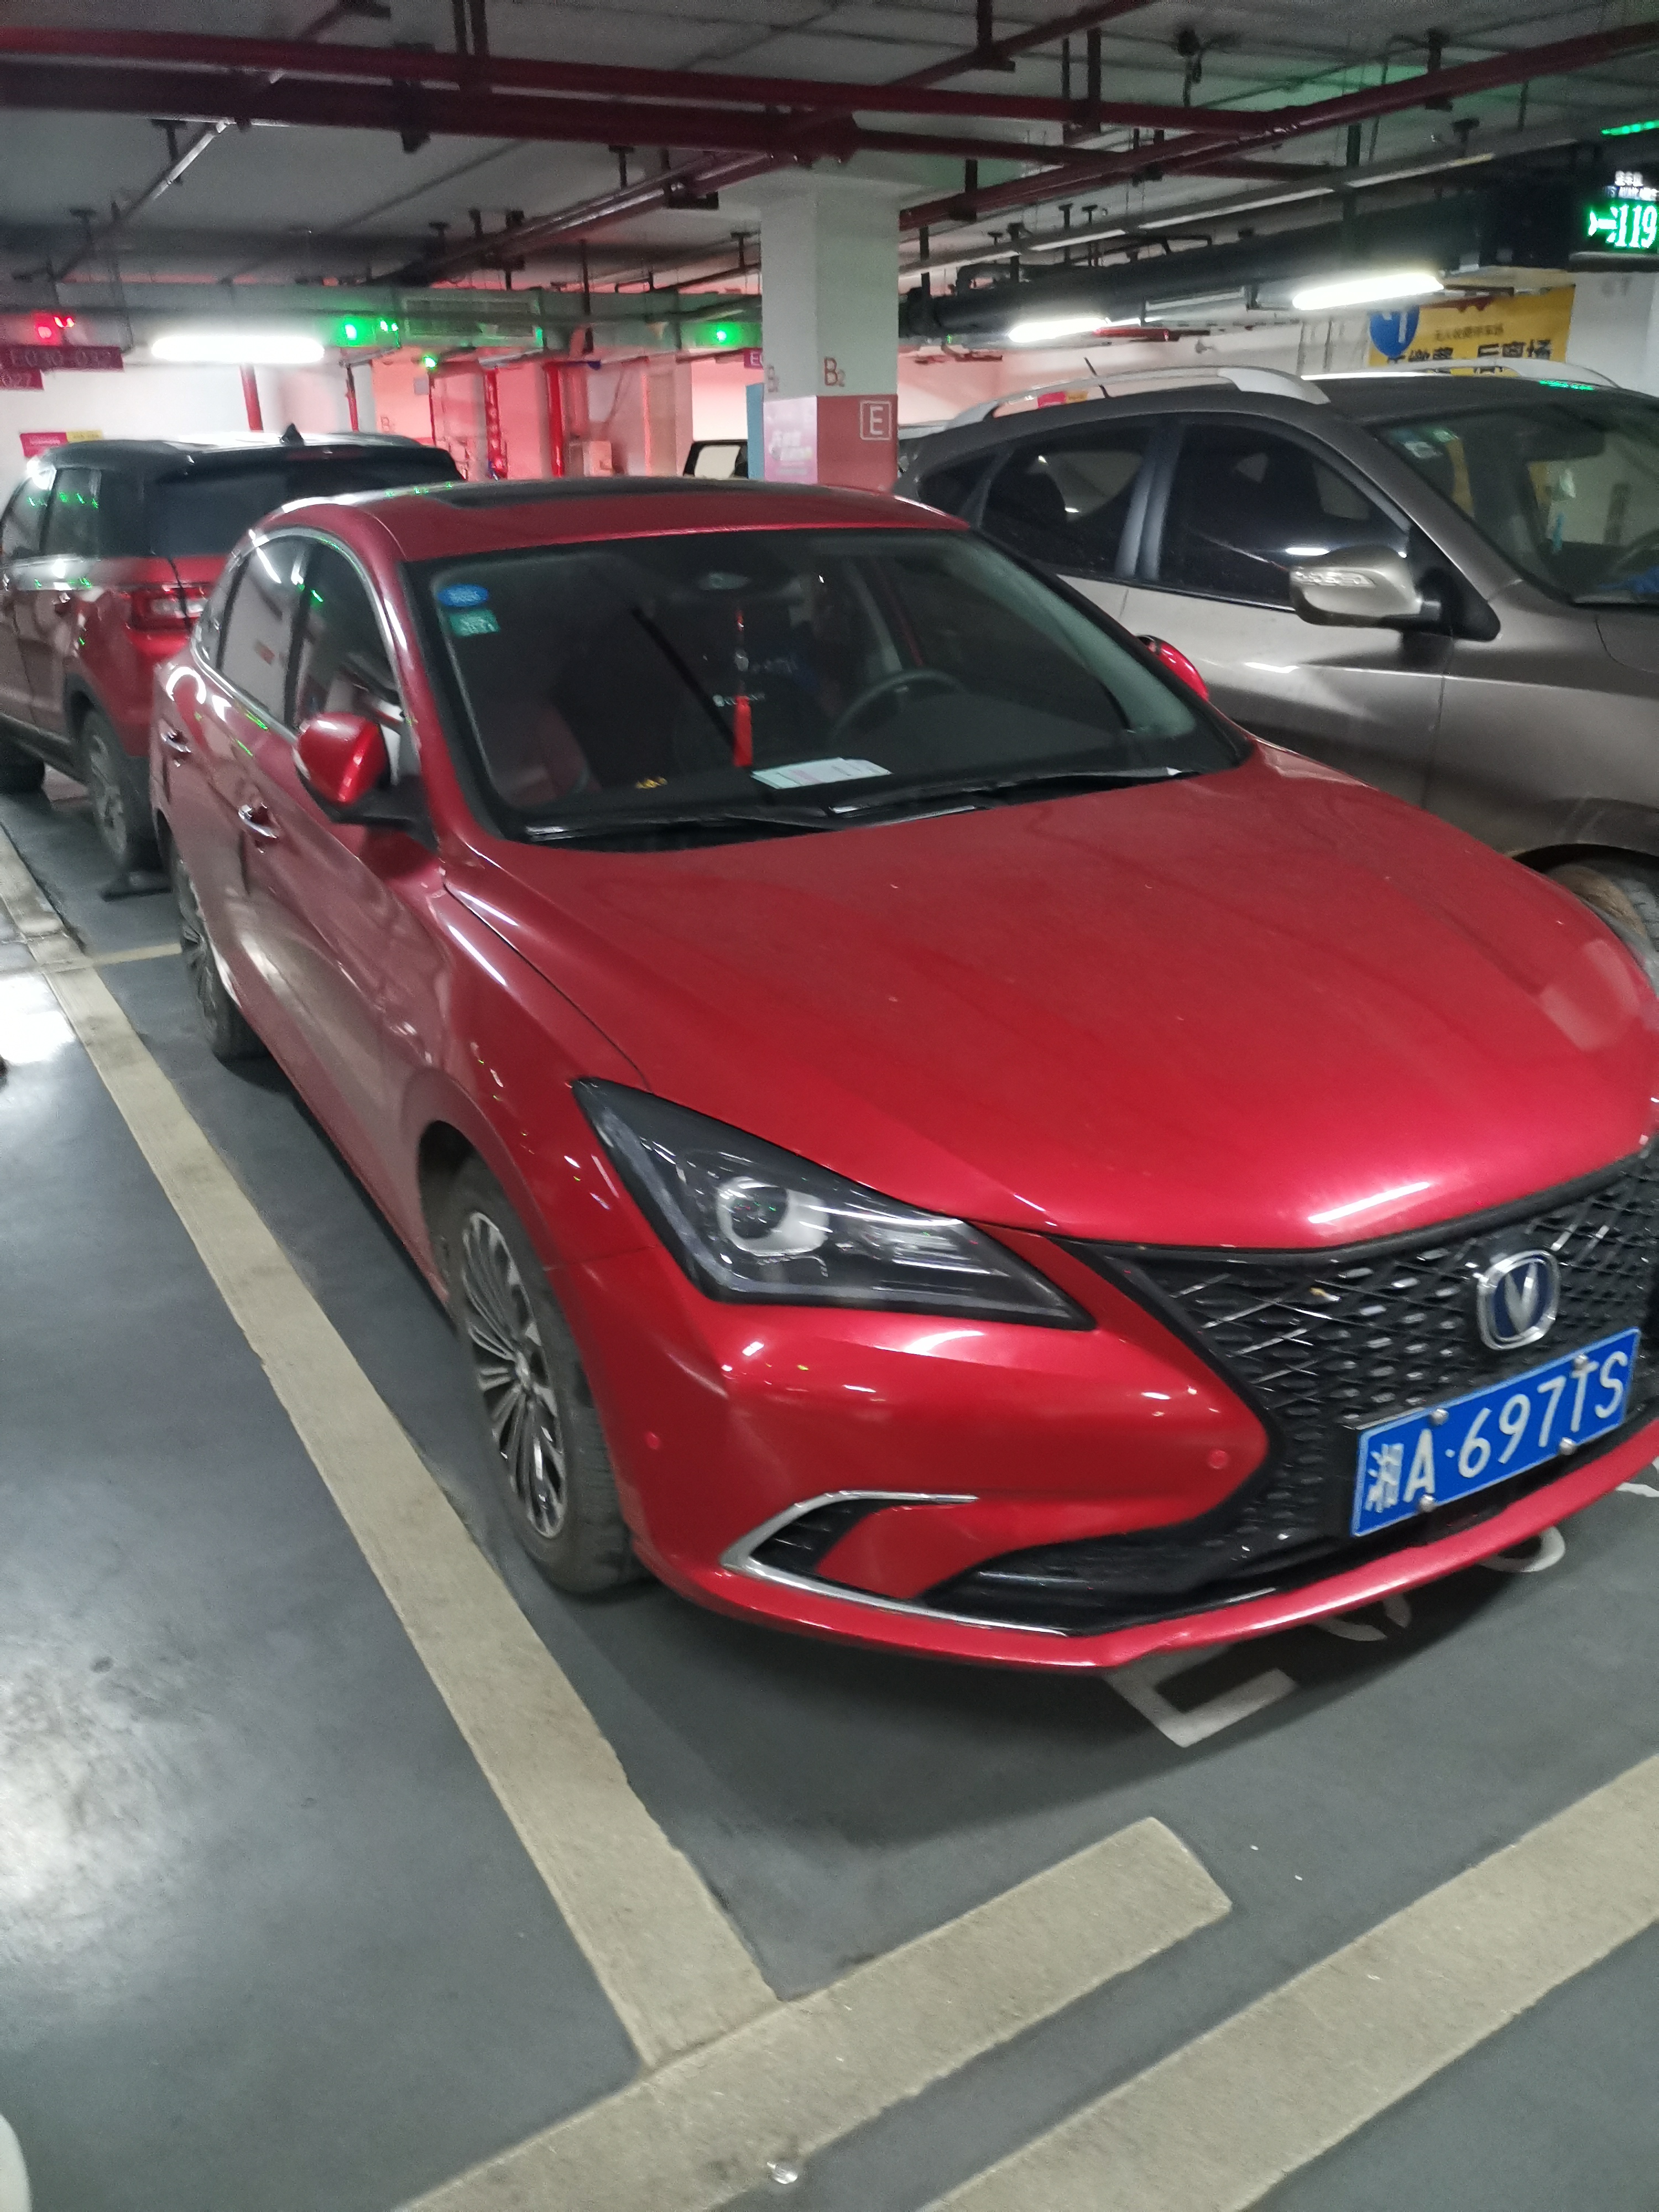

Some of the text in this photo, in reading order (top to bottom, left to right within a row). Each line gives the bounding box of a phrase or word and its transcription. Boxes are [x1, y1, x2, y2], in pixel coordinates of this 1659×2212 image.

[1615, 204, 1657, 248] 119
[824, 357, 846, 387] B2
[869, 406, 884, 435] E
